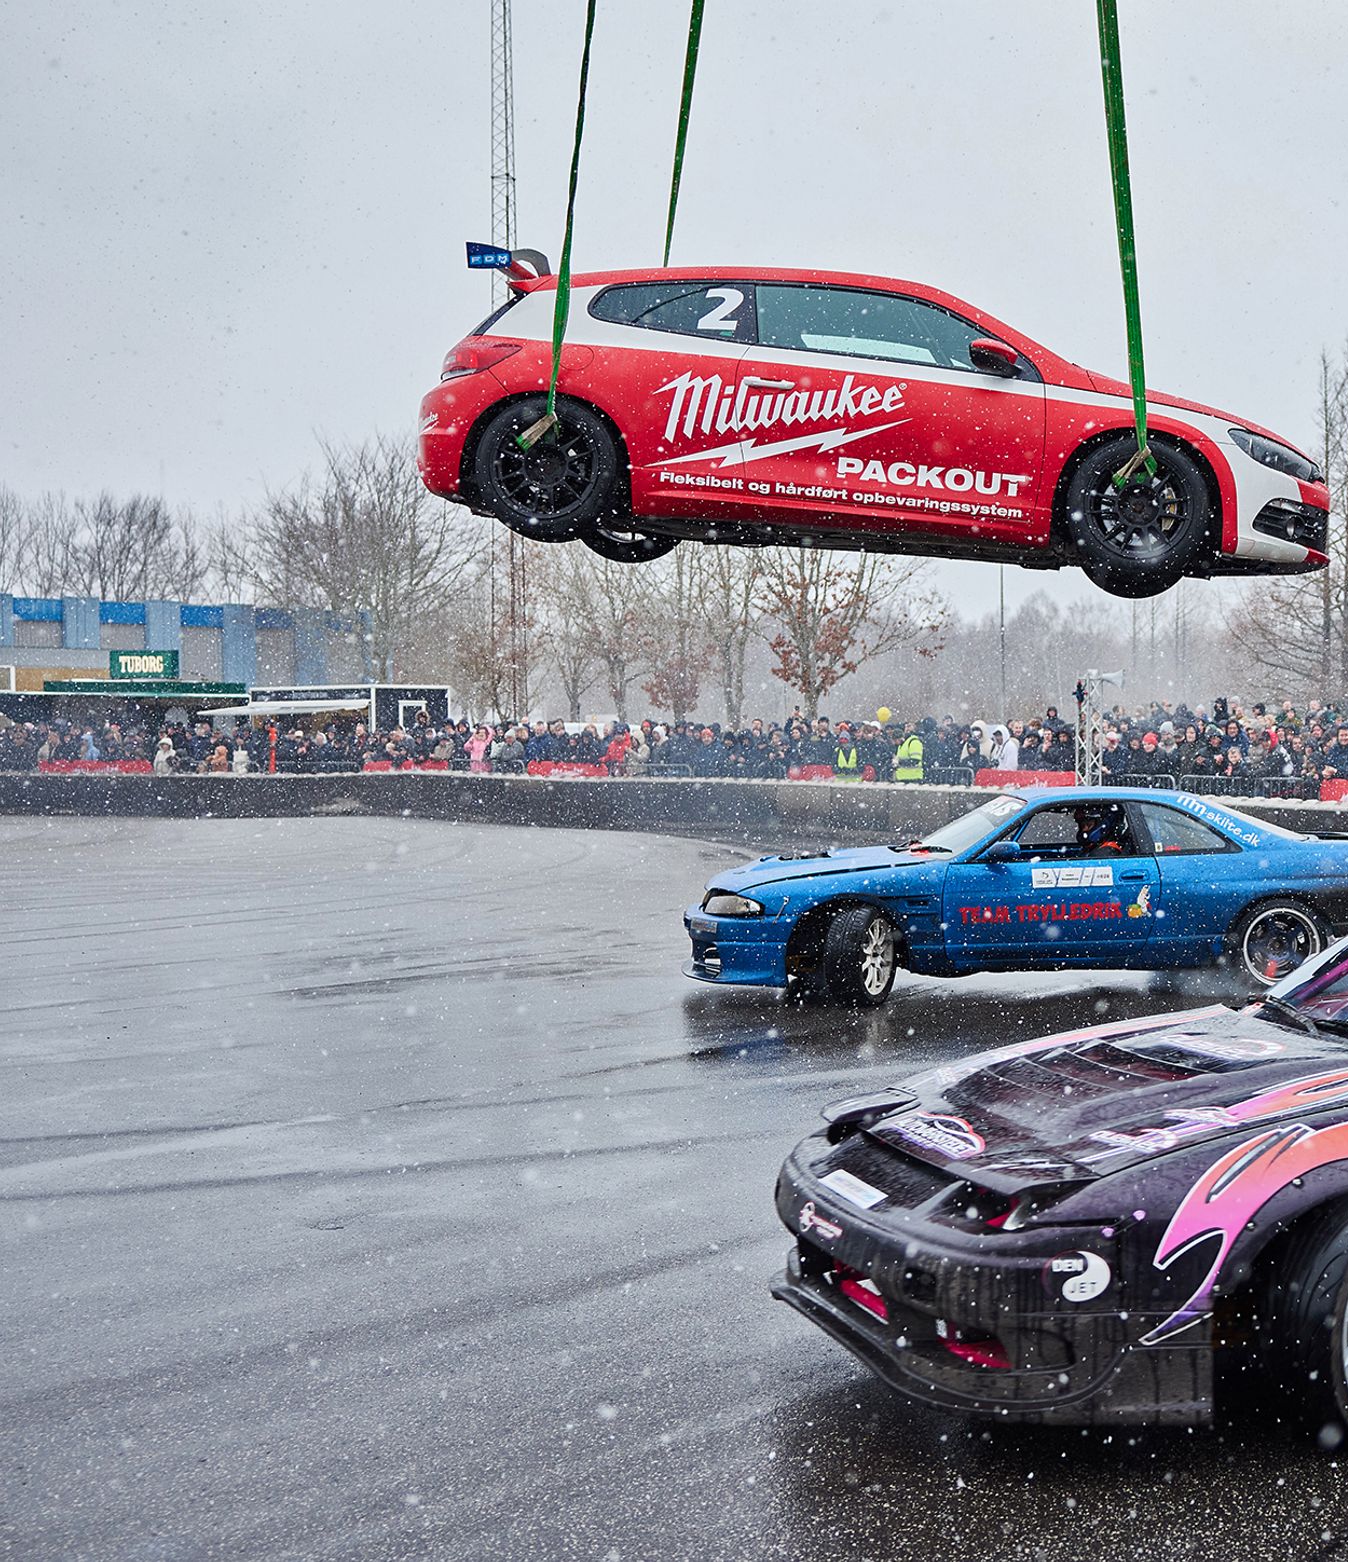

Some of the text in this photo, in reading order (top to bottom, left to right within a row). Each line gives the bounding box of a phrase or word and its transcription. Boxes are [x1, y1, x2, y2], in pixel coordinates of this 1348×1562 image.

[471, 255, 509, 265] FDM
[697, 288, 744, 331] 2
[836, 456, 1026, 497] PACKOUT
[659, 471, 1023, 518] Fleksibelt og hårdført opbevaringssystem
[118, 655, 164, 673] TUBORG
[959, 902, 1124, 925] TEAM TRYLLEDRIK
[1052, 1258, 1084, 1272] DEN
[1070, 1281, 1097, 1294] JET
